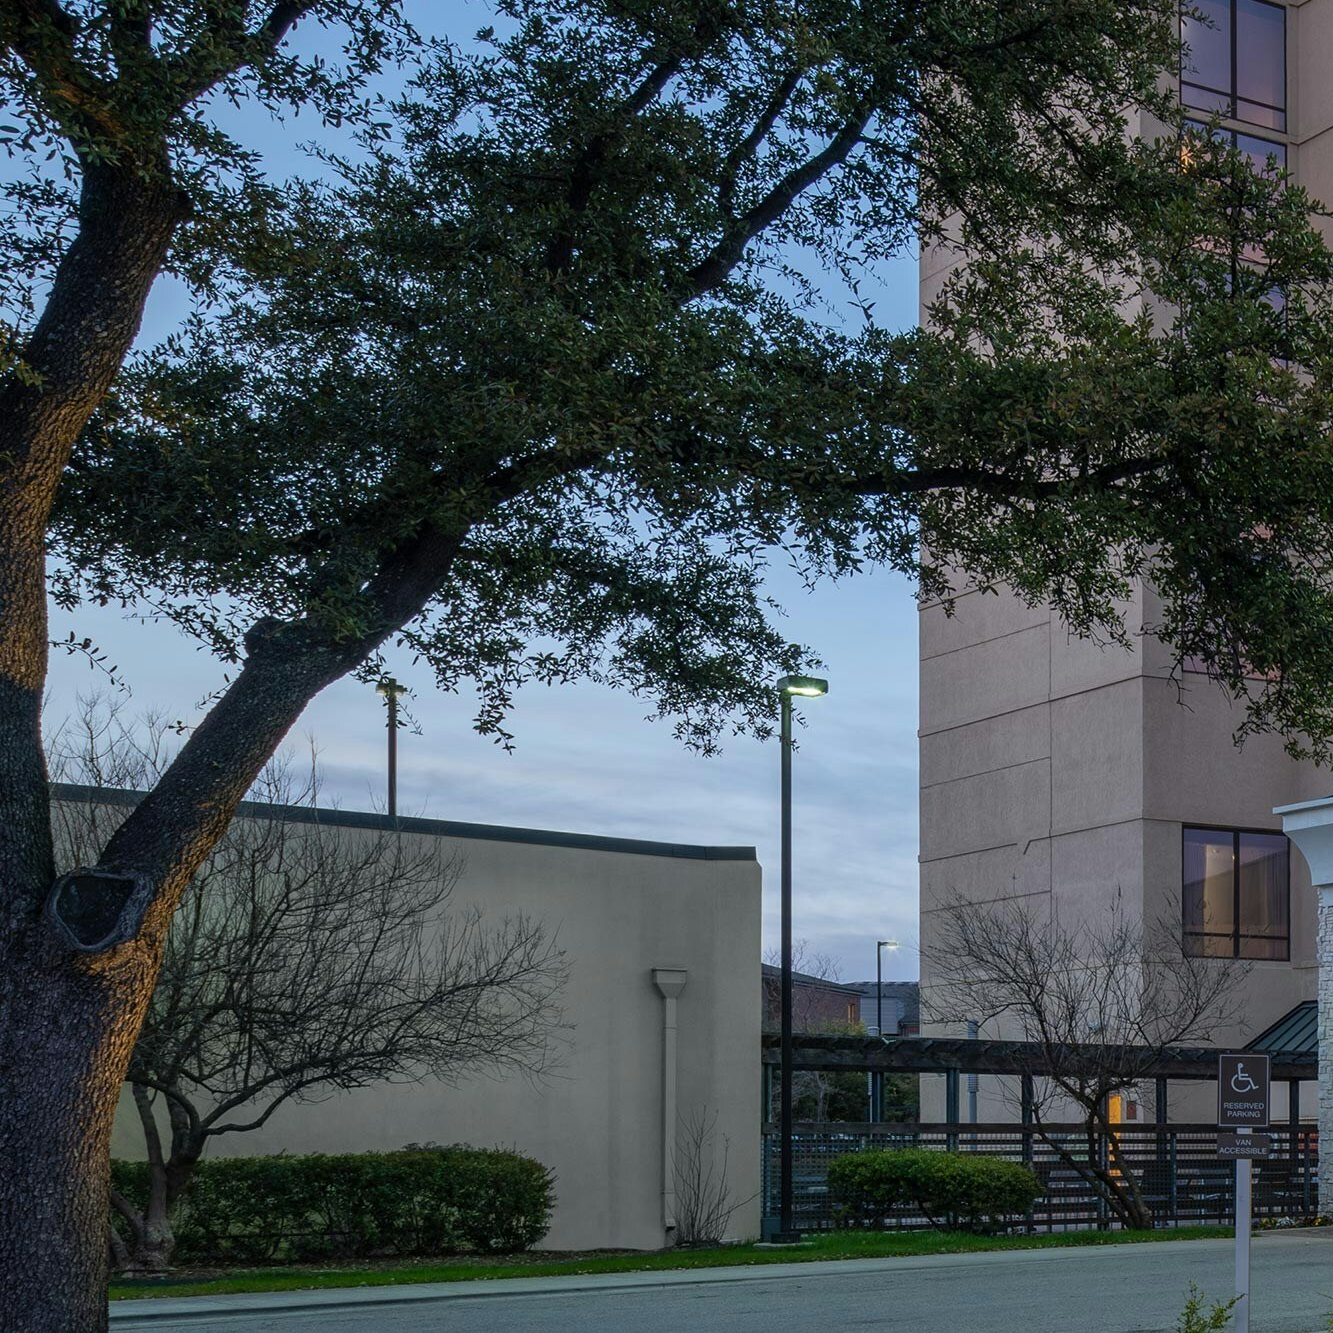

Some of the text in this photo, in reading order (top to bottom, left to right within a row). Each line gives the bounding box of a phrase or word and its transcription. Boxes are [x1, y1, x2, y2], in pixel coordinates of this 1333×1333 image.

[1223, 1102, 1265, 1110] RESERVED
[1227, 1110, 1261, 1118] PARKING
[1219, 1147, 1267, 1155] ACCESSIBLE
